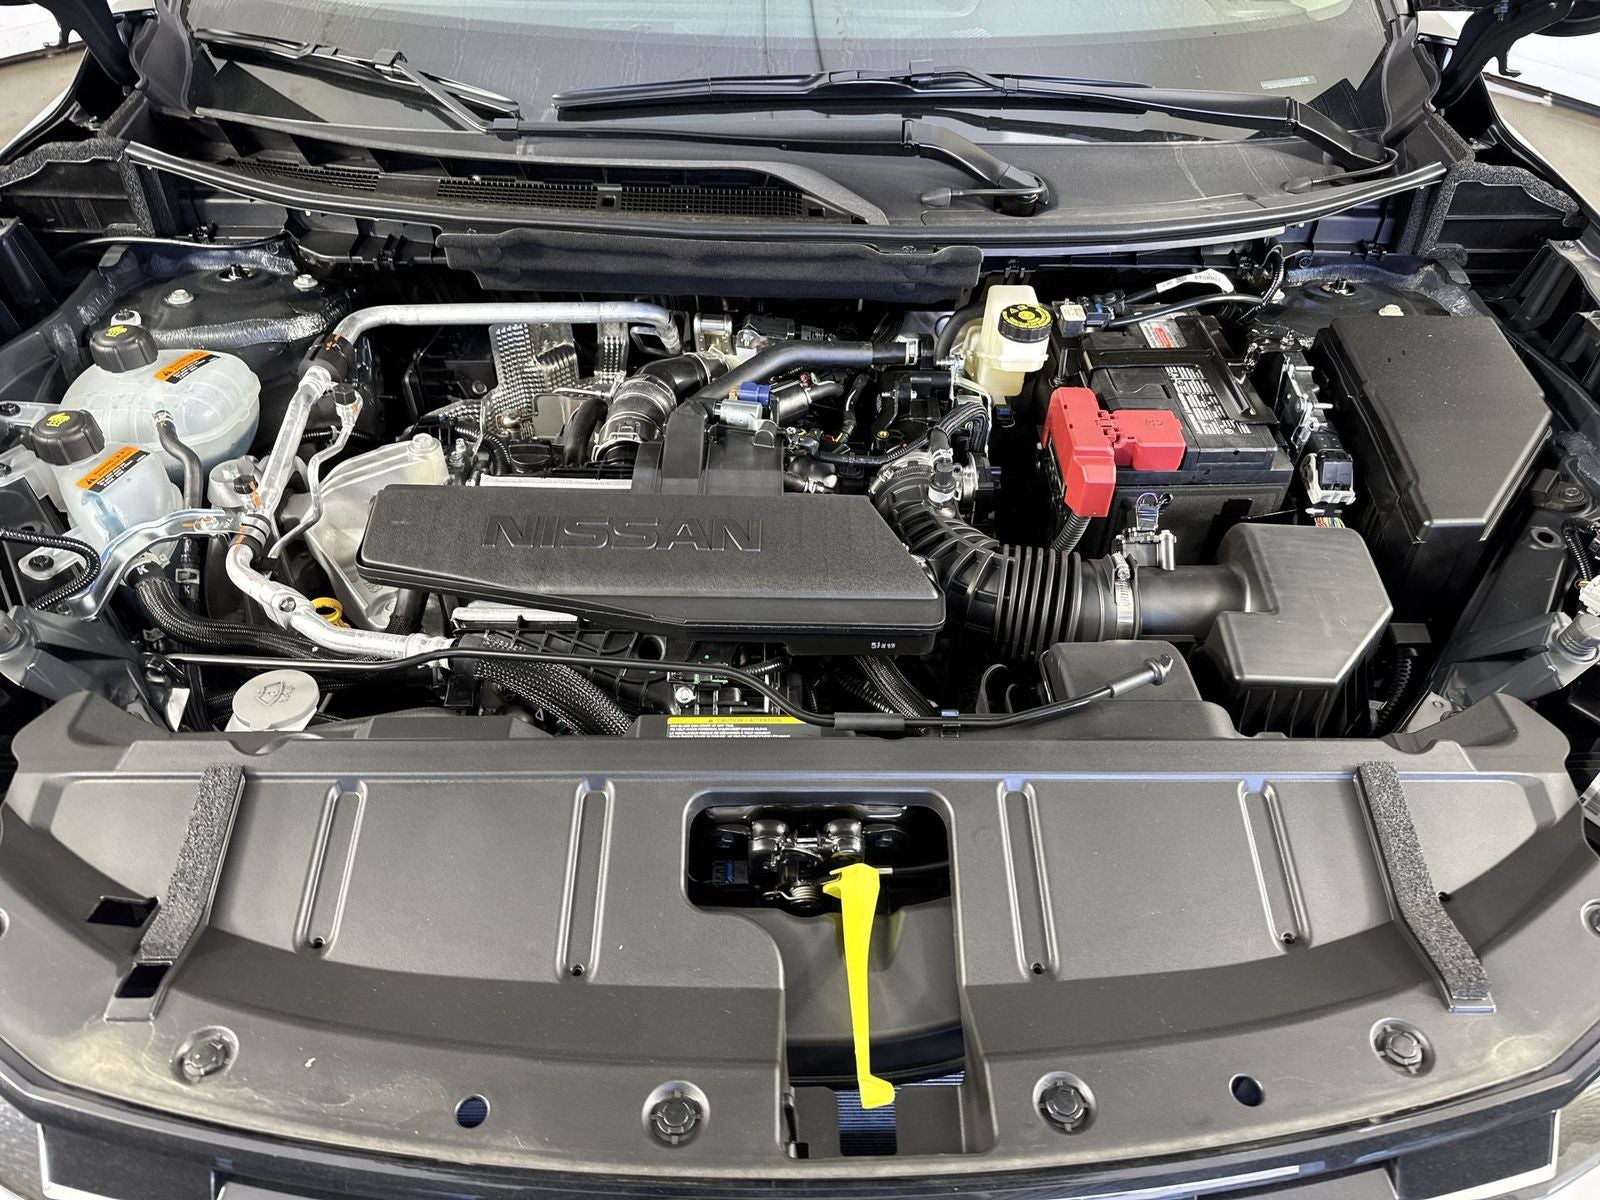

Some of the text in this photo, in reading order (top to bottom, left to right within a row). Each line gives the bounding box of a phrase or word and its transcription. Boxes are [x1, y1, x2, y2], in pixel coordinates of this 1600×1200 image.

[481, 515, 763, 552] NISSAN
[136, 564, 149, 576] K
[184, 585, 190, 594] K
